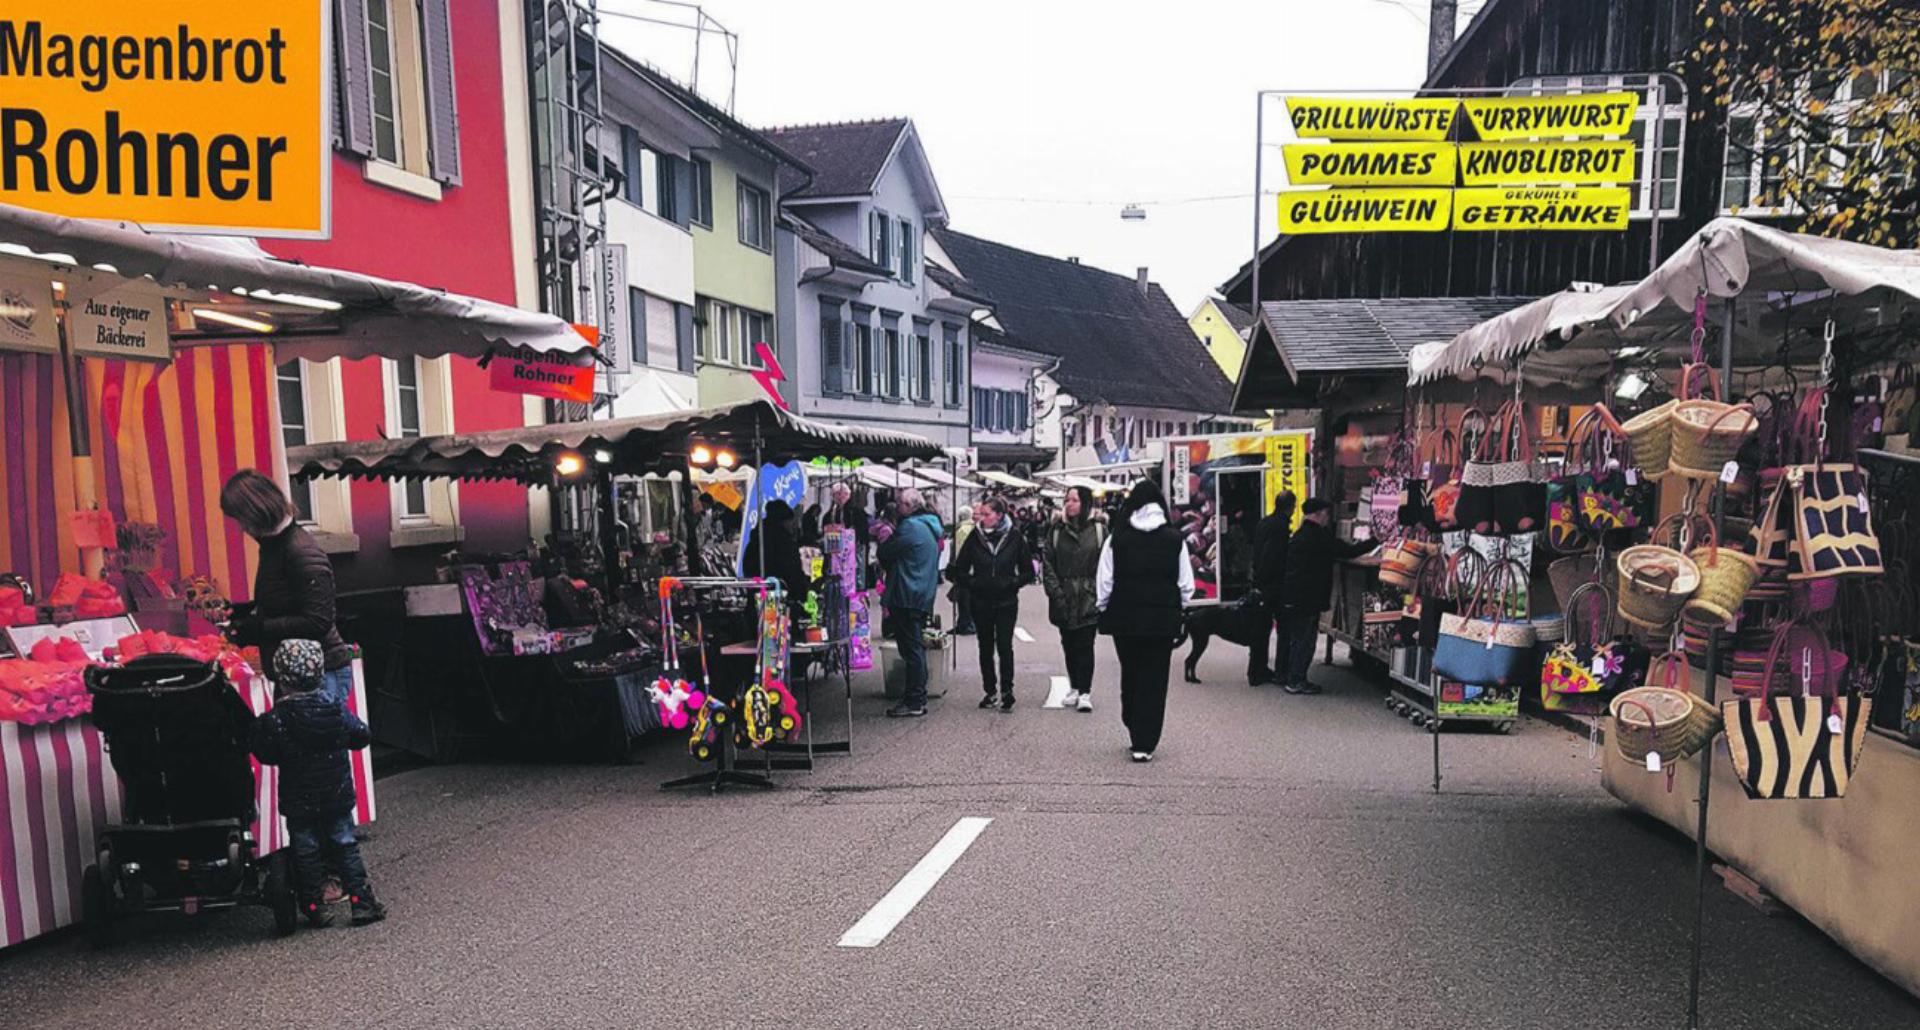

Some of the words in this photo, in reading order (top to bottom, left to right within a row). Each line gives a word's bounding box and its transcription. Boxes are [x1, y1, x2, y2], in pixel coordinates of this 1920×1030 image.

[0, 20, 286, 92] Magenbrot
[1291, 102, 1450, 131] GRILLWÜRSTE
[1, 107, 286, 202] Rohner
[1300, 151, 1436, 176] POMMES
[1465, 148, 1626, 177] KNOBLIBROT
[1290, 193, 1437, 224] GLÜHWEIN
[1505, 190, 1579, 201] GEKÜHLTE
[1462, 201, 1621, 224] GETRÄNKE
[85, 297, 107, 317] Aus
[110, 299, 151, 325] eigener
[96, 324, 146, 347] Bäckerei
[513, 365, 575, 385] Rohner
